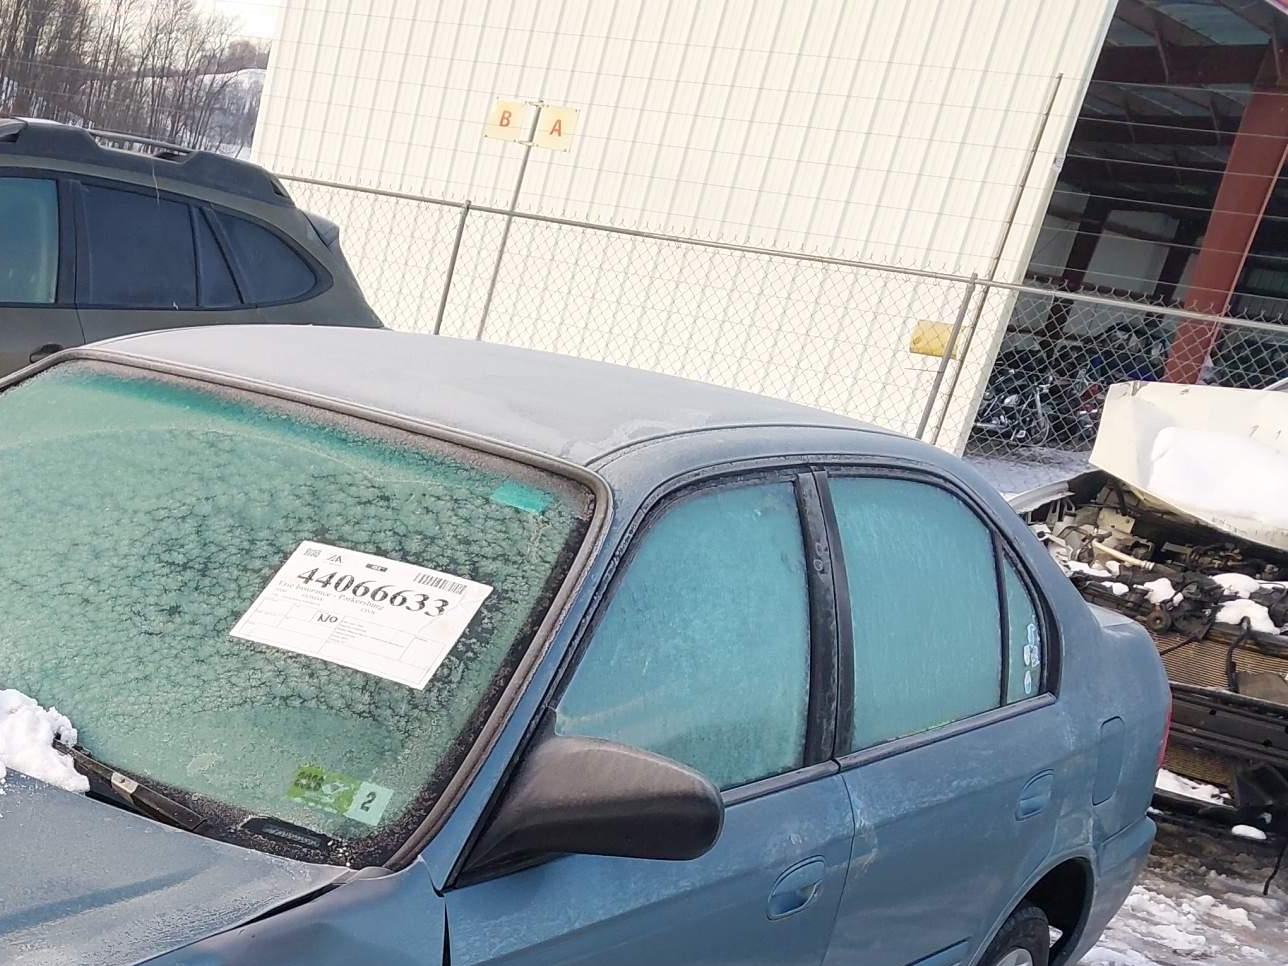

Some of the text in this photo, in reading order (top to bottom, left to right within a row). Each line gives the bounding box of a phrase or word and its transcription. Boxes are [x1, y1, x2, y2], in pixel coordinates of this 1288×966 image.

[499, 109, 512, 128] B
[549, 119, 562, 137] A
[297, 567, 450, 618] 44066633
[359, 791, 377, 813] 2
